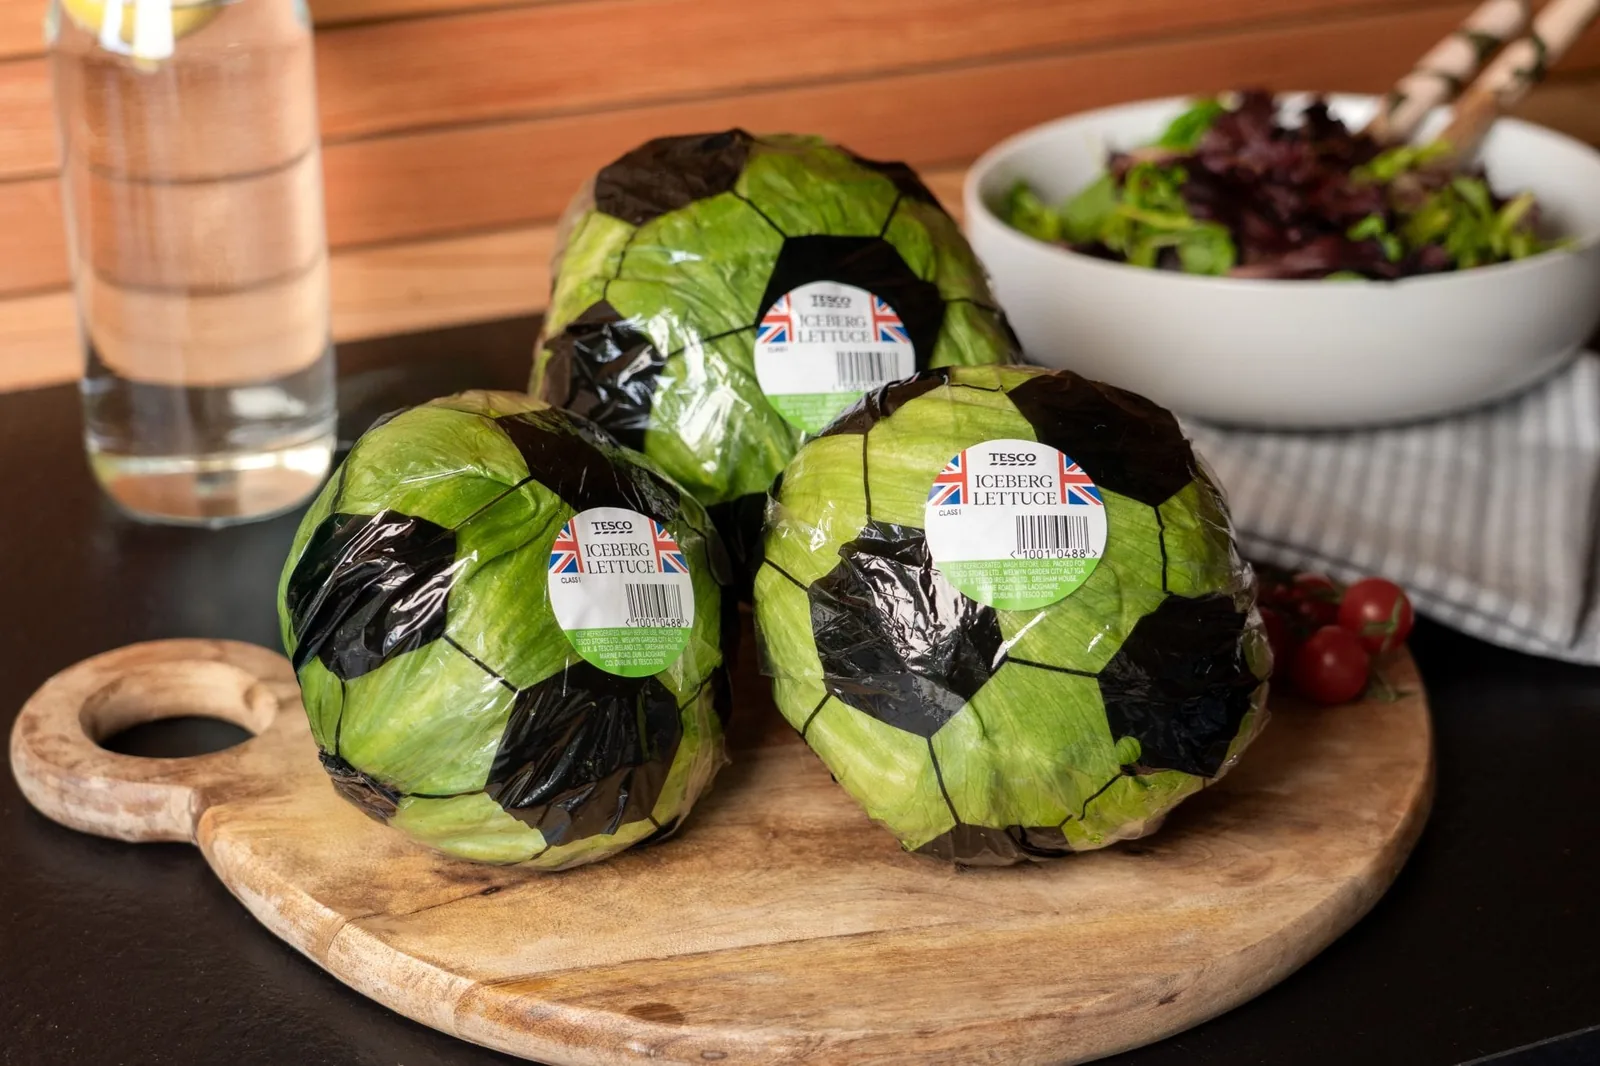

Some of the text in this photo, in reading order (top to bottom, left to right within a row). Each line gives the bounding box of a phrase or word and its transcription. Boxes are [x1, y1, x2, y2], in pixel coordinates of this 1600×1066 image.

[811, 294, 851, 303] TESCO
[800, 314, 867, 328] ICEBERG
[798, 331, 872, 343] LETTUCE
[989, 452, 1036, 462] TESCO
[975, 474, 1053, 488] ICEBERG
[973, 492, 1057, 506] LETTUCE
[591, 520, 633, 530] TESCO
[584, 542, 650, 557] ICEBERG
[587, 560, 656, 574] LETTUCE
